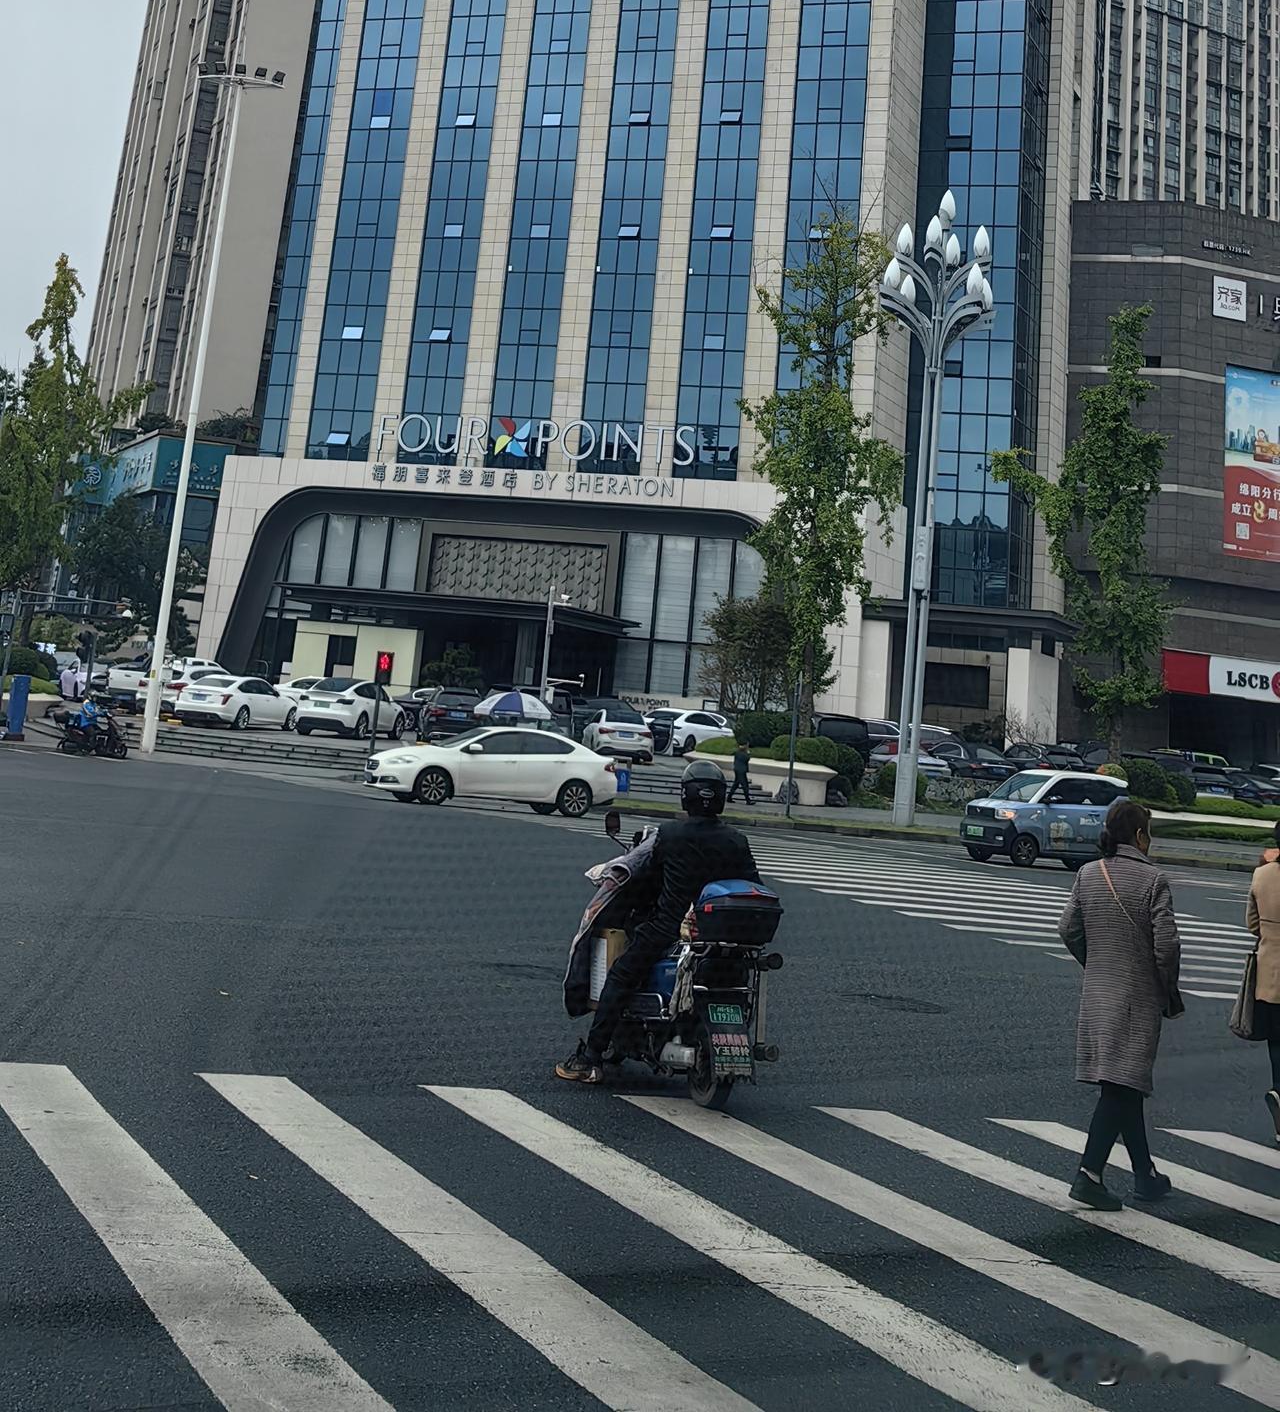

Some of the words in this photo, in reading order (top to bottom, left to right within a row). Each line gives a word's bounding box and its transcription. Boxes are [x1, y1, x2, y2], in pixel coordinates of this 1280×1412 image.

[1217, 285, 1242, 306] 齐家
[376, 413, 489, 456] FOUR
[536, 419, 696, 467] POINTS
[371, 462, 517, 489] 福朋喜来登酒店
[532, 472, 557, 491] BY
[565, 473, 675, 498] SHERATON
[1231, 499, 1280, 523] 成立8周
[1226, 670, 1270, 690] LSCB
[646, 698, 670, 707] POINTS
